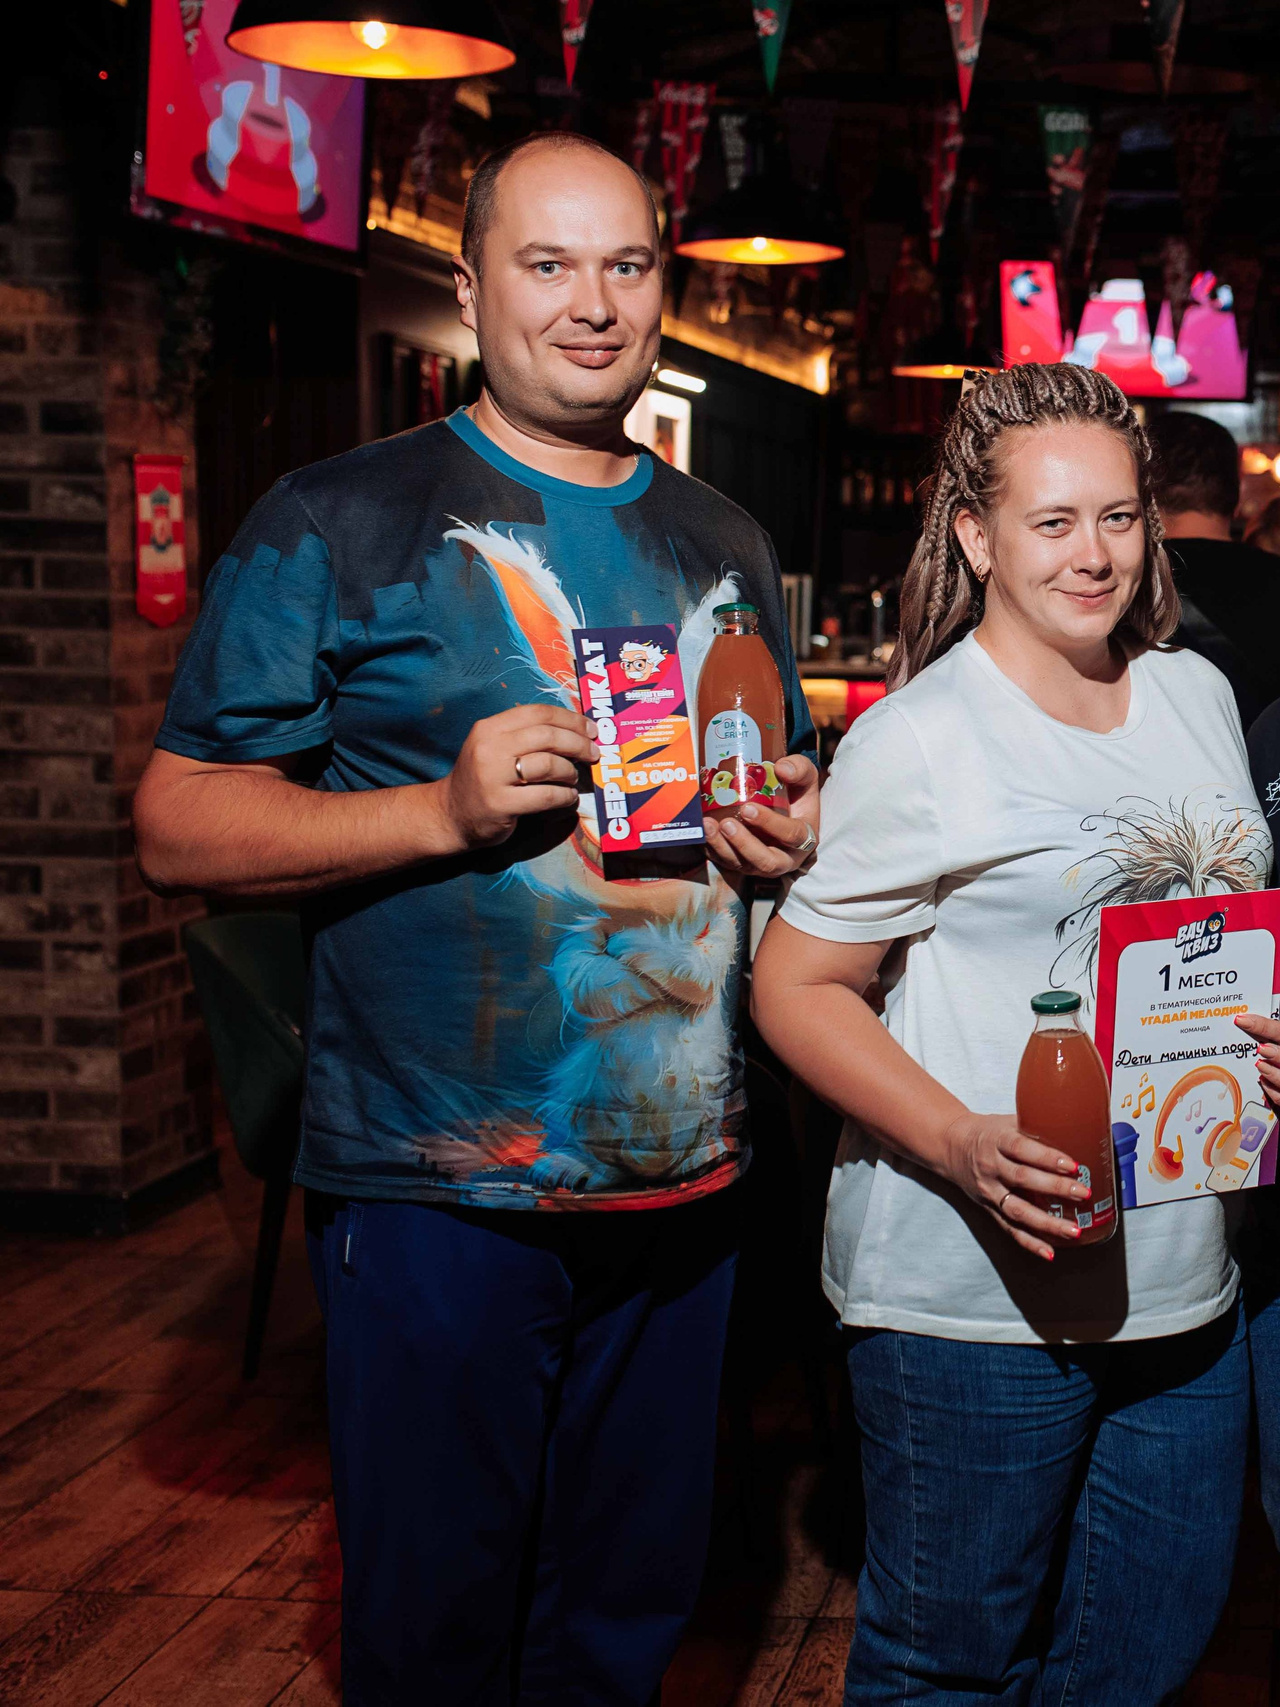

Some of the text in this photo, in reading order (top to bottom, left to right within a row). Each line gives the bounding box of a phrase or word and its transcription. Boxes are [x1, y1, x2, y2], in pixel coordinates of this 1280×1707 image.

[1113, 307, 1138, 345] 1
[724, 720, 747, 729] DAA
[581, 638, 631, 841] СЕРТИФИКАТ
[627, 770, 648, 786] 13
[649, 767, 687, 784] 000
[1175, 919, 1207, 947] ВАУ
[1182, 933, 1221, 961] КВИЗ
[1159, 964, 1238, 991] 1 МЕСТО
[1158, 994, 1221, 1010] ТЕМАТИЧЕСКОЙ
[1223, 993, 1243, 1002] ИГРЕ
[1140, 1004, 1249, 1026] УГАДАЙ МЕЛОДИЮ
[1180, 1025, 1211, 1034] КОМАНДА
[1115, 1049, 1152, 1067] Дети
[1160, 1045, 1217, 1062] маминых
